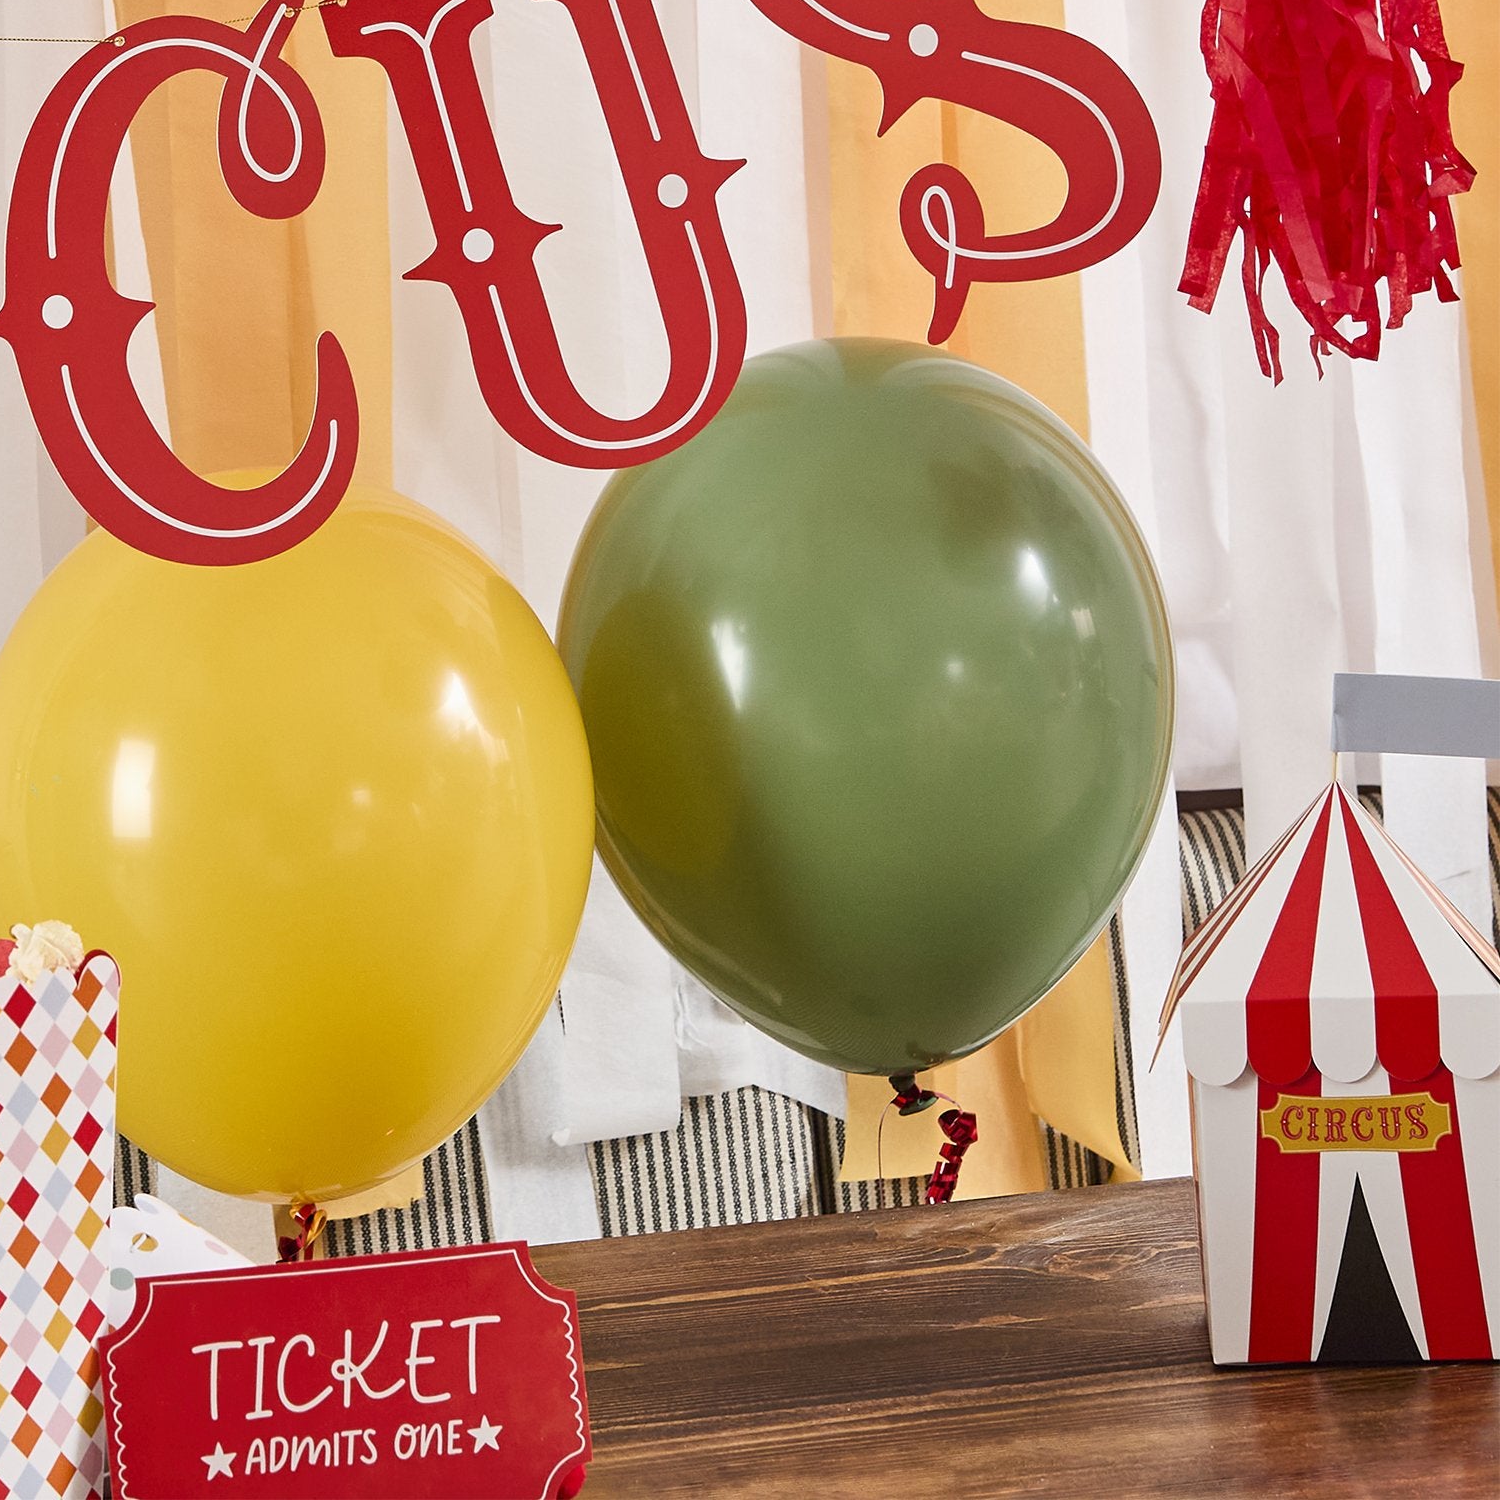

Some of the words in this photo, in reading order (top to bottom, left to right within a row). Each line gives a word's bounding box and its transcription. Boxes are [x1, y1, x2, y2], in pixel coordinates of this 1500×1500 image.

[1279, 1102, 1429, 1143] CIRCUS
[191, 1314, 501, 1421] TICKET
[244, 1428, 379, 1476] ADMITS
[393, 1419, 463, 1460] ONE
